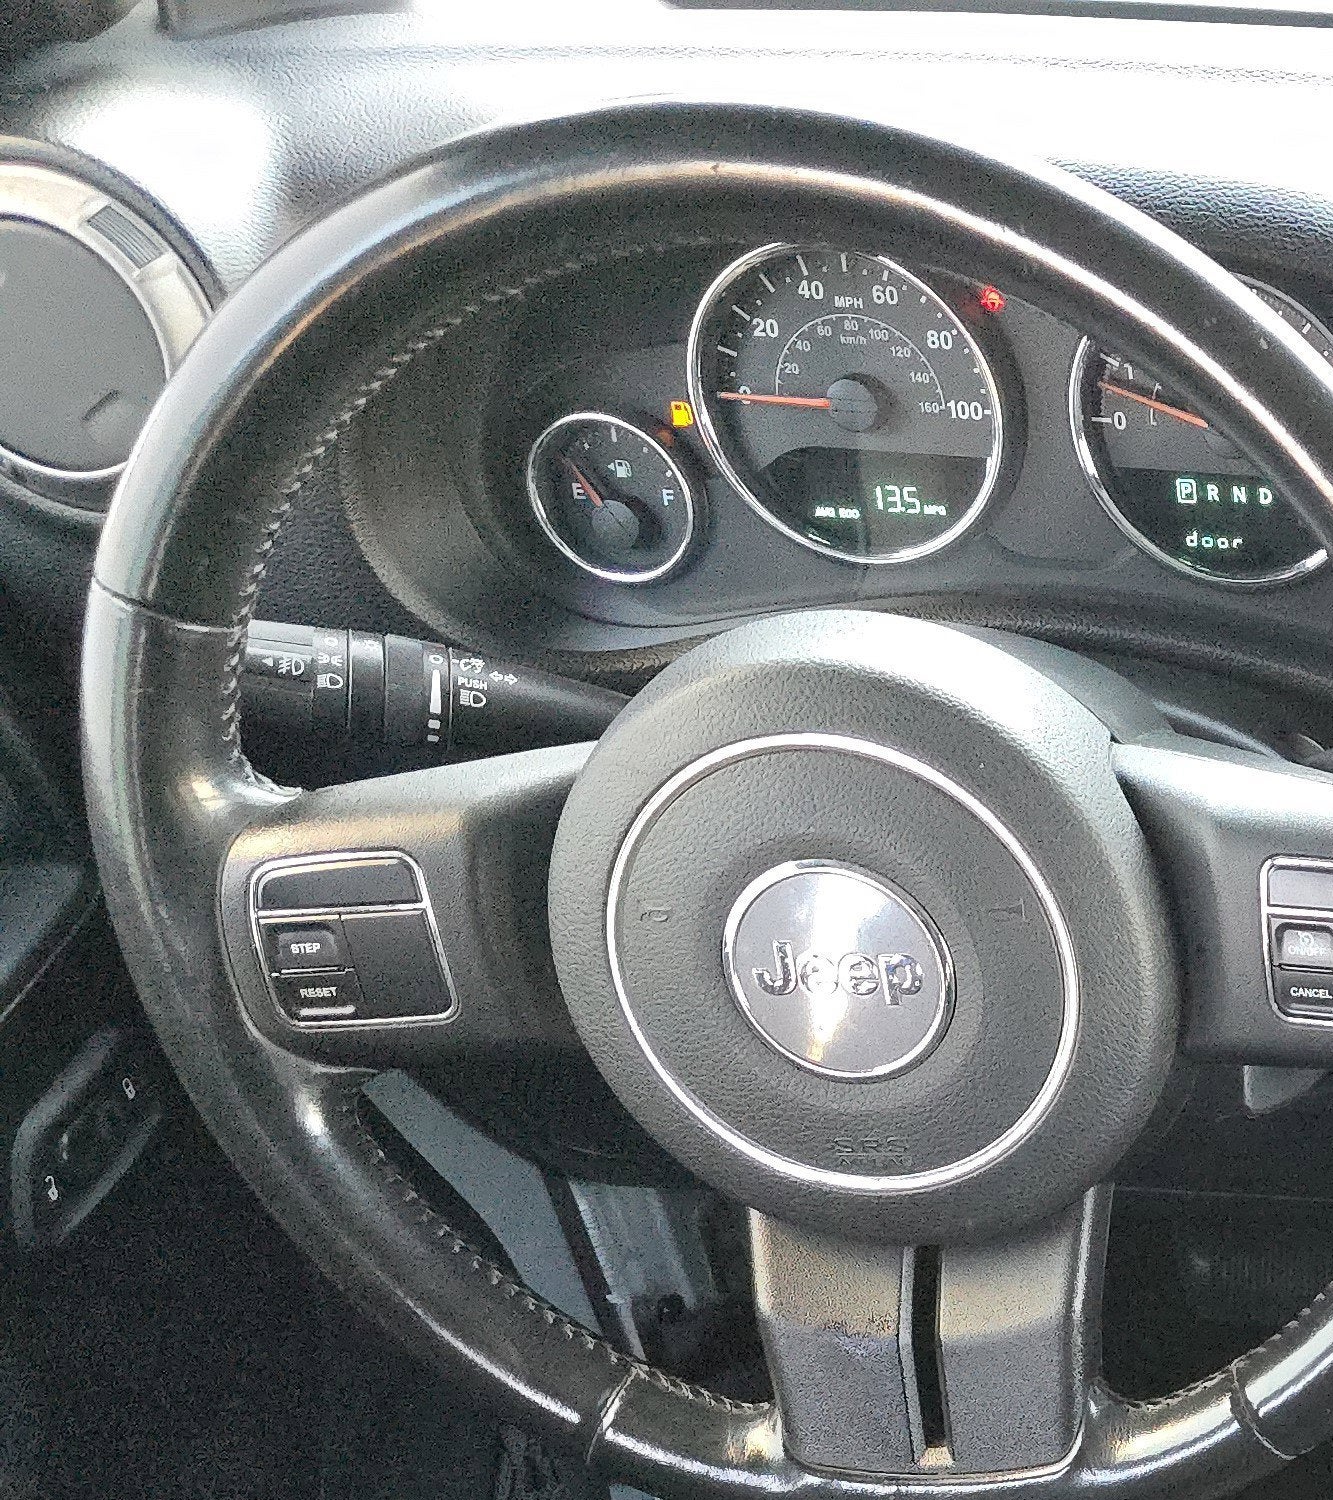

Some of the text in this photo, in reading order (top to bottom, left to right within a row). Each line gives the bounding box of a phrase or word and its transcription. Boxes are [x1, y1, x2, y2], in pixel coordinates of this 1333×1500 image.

[798, 280, 824, 300] 40
[872, 285, 898, 305] 60
[834, 296, 863, 309] MPH
[752, 318, 778, 338] 20
[817, 325, 832, 337] 60
[843, 320, 859, 331] 80
[840, 334, 867, 346] km/h
[868, 328, 889, 341] 100
[926, 330, 952, 350] 80
[795, 340, 811, 352] 40
[890, 346, 911, 358] 120
[783, 363, 799, 375] 20
[909, 371, 930, 384] 140
[919, 402, 939, 414] 160
[947, 401, 983, 421] 100
[1113, 411, 1127, 430] 0
[572, 482, 586, 500] E
[662, 488, 675, 507] F
[1180, 482, 1274, 505] P R N D
[1185, 530, 1244, 549] door
[457, 675, 488, 691] PUSH
[290, 942, 321, 954] STEP
[751, 938, 926, 1006] Jeep
[299, 986, 338, 999] RESET
[1289, 986, 1333, 999] CANCEL
